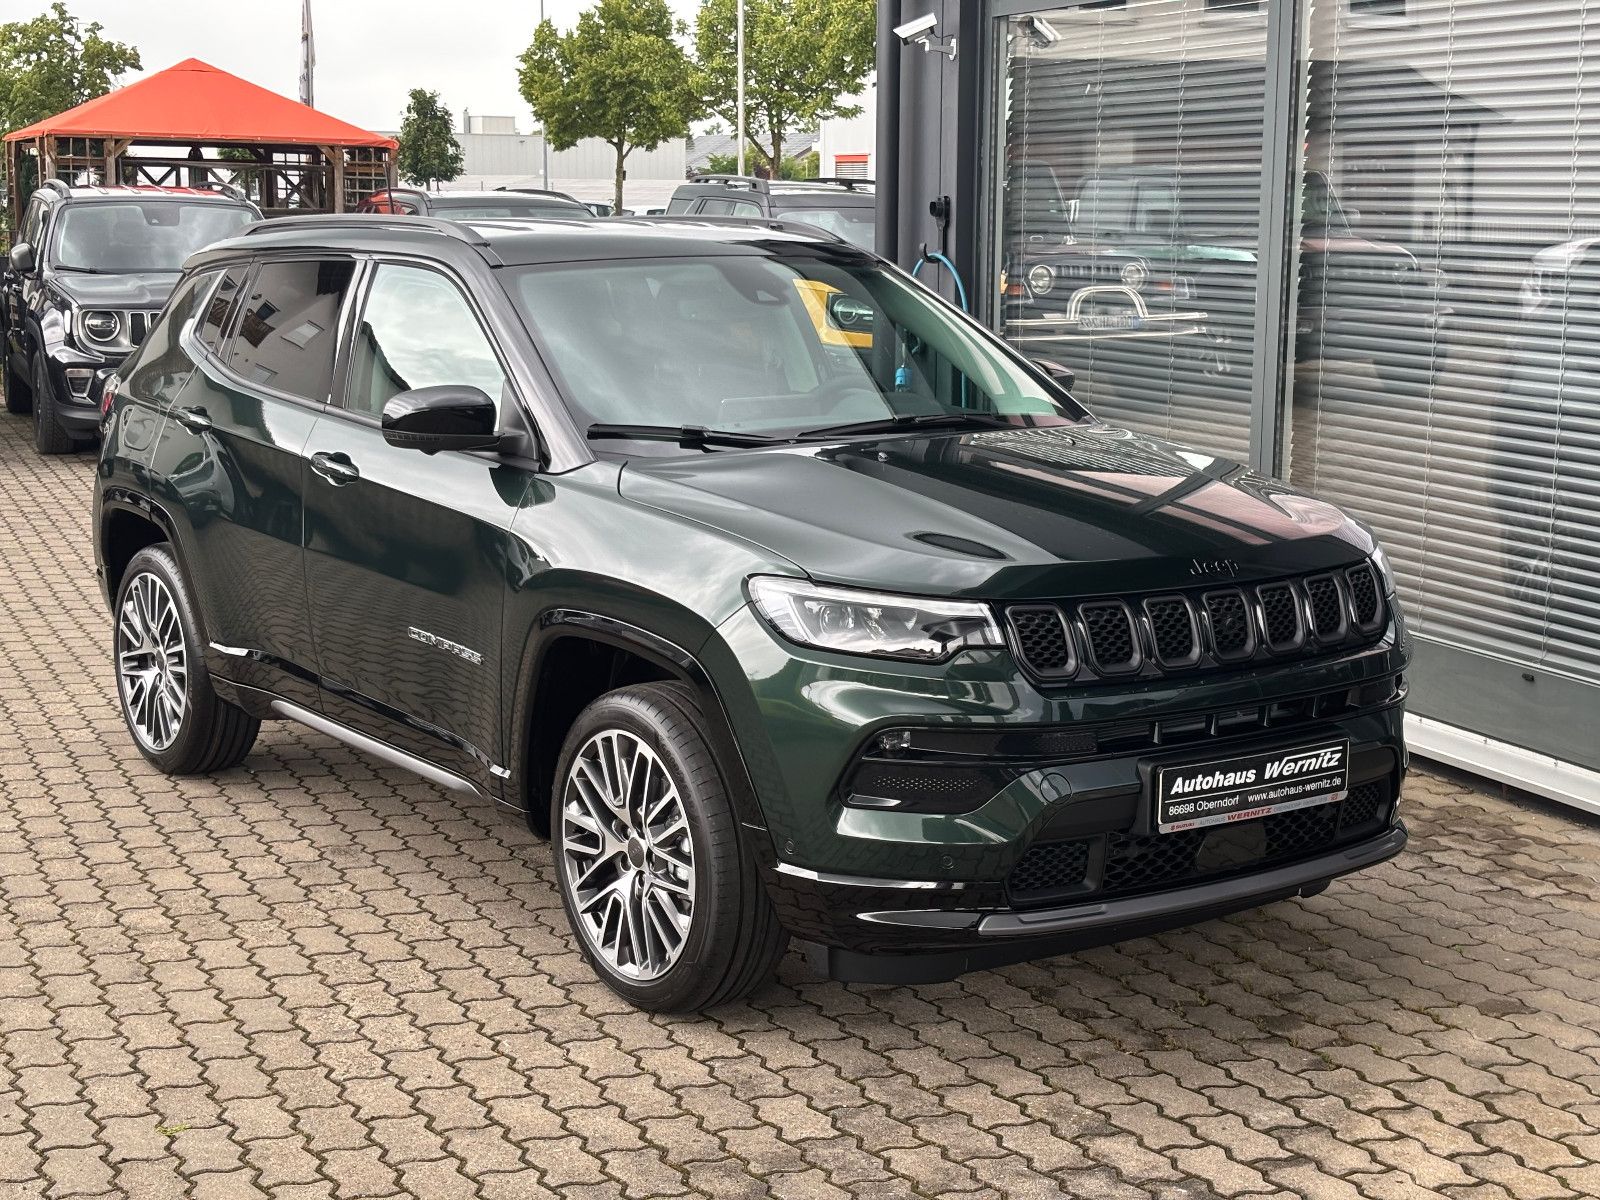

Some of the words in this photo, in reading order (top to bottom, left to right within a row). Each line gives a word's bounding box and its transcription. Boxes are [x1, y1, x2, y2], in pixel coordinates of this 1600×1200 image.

[1189, 558, 1239, 578] Jeep
[1170, 769, 1256, 795] Autohaus
[1264, 748, 1342, 780] Wernitz
[1168, 802, 1195, 816] 86698
[1196, 795, 1239, 811] Oberndorf
[1247, 776, 1342, 802] www.autohaus-wernitz.de
[1227, 807, 1272, 821] WERNITZ
